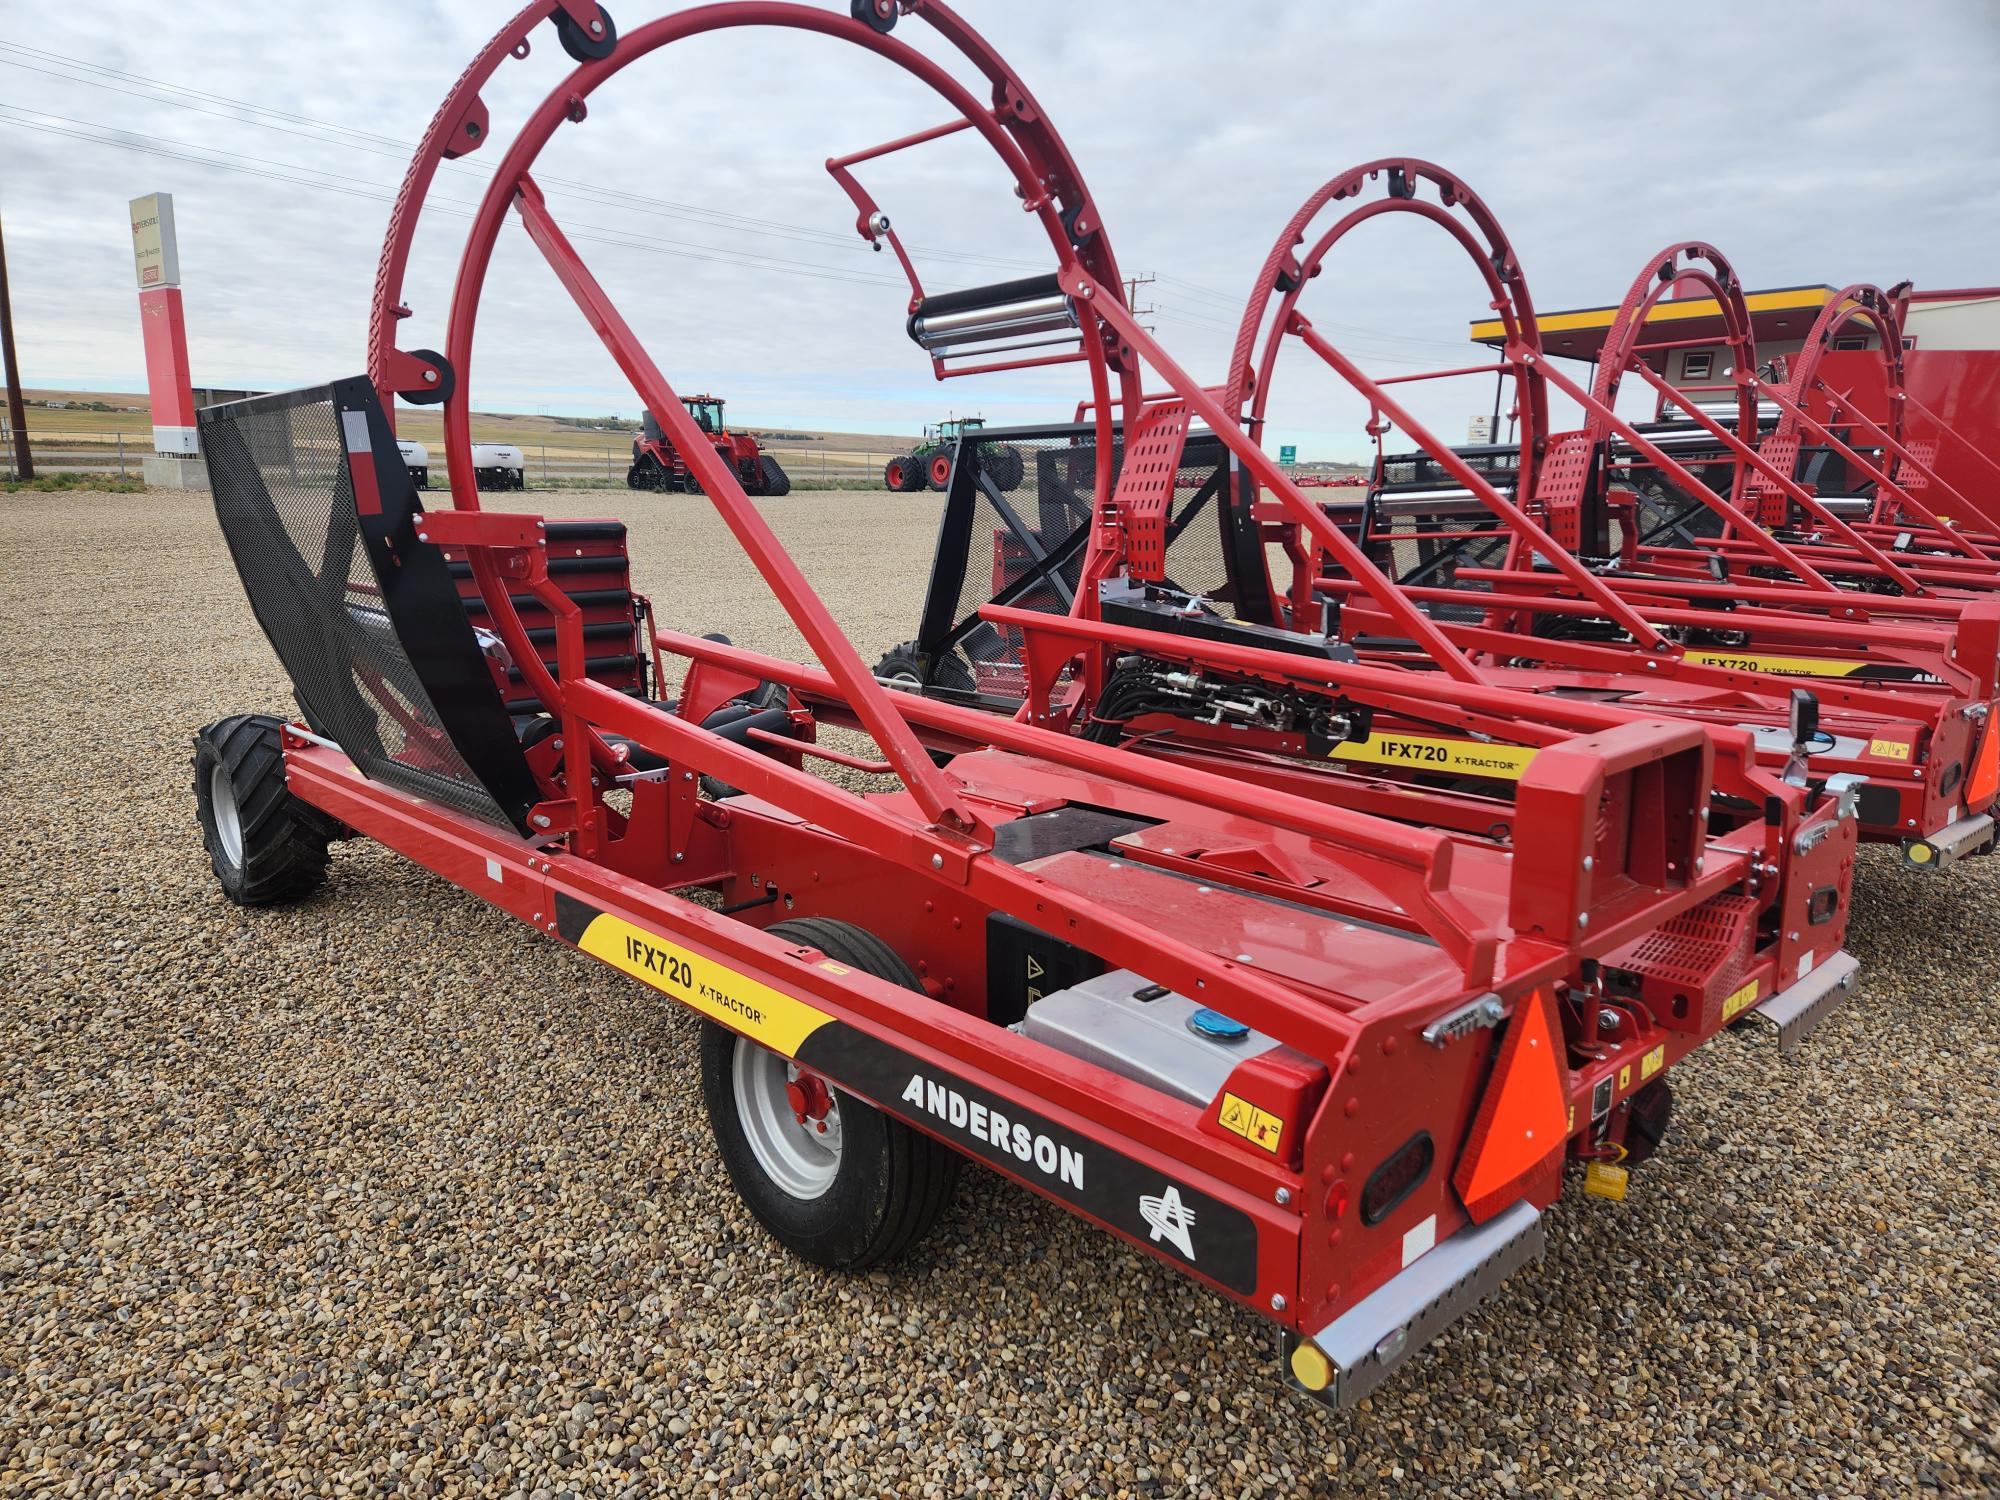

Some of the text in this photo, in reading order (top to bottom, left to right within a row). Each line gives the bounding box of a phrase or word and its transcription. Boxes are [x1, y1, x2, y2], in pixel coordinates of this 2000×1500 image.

[1381, 741, 1447, 763] IFX720
[626, 935, 692, 989] IFX720
[902, 1074, 1084, 1190] ANDERSON
